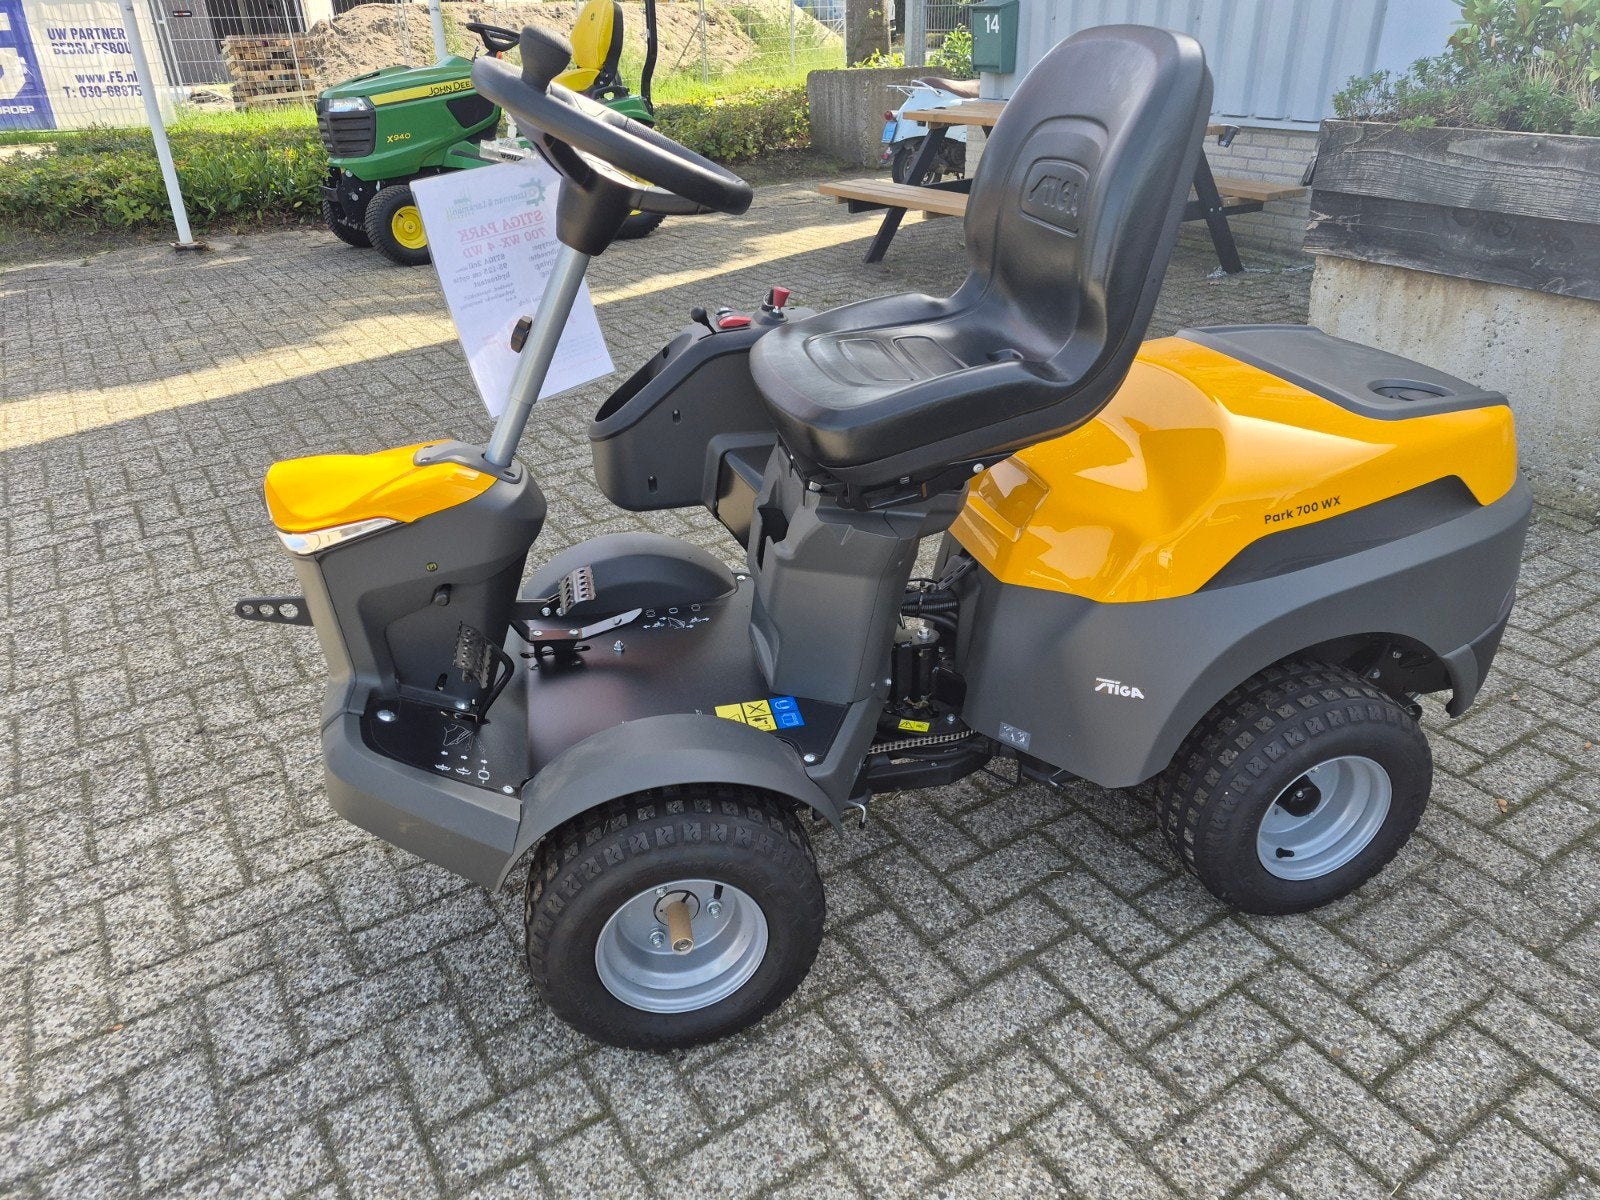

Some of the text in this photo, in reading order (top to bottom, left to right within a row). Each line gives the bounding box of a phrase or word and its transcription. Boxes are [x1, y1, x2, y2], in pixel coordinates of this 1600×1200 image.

[984, 14, 1000, 34] 14
[47, 28, 126, 40] UW PARTNER
[75, 71, 138, 84] www.F5.nl
[63, 86, 77, 98] T:
[429, 85, 452, 96] JOHN
[386, 132, 411, 143] X940
[1264, 496, 1341, 524] Park 700 WX
[1095, 677, 1145, 700] STIGA
